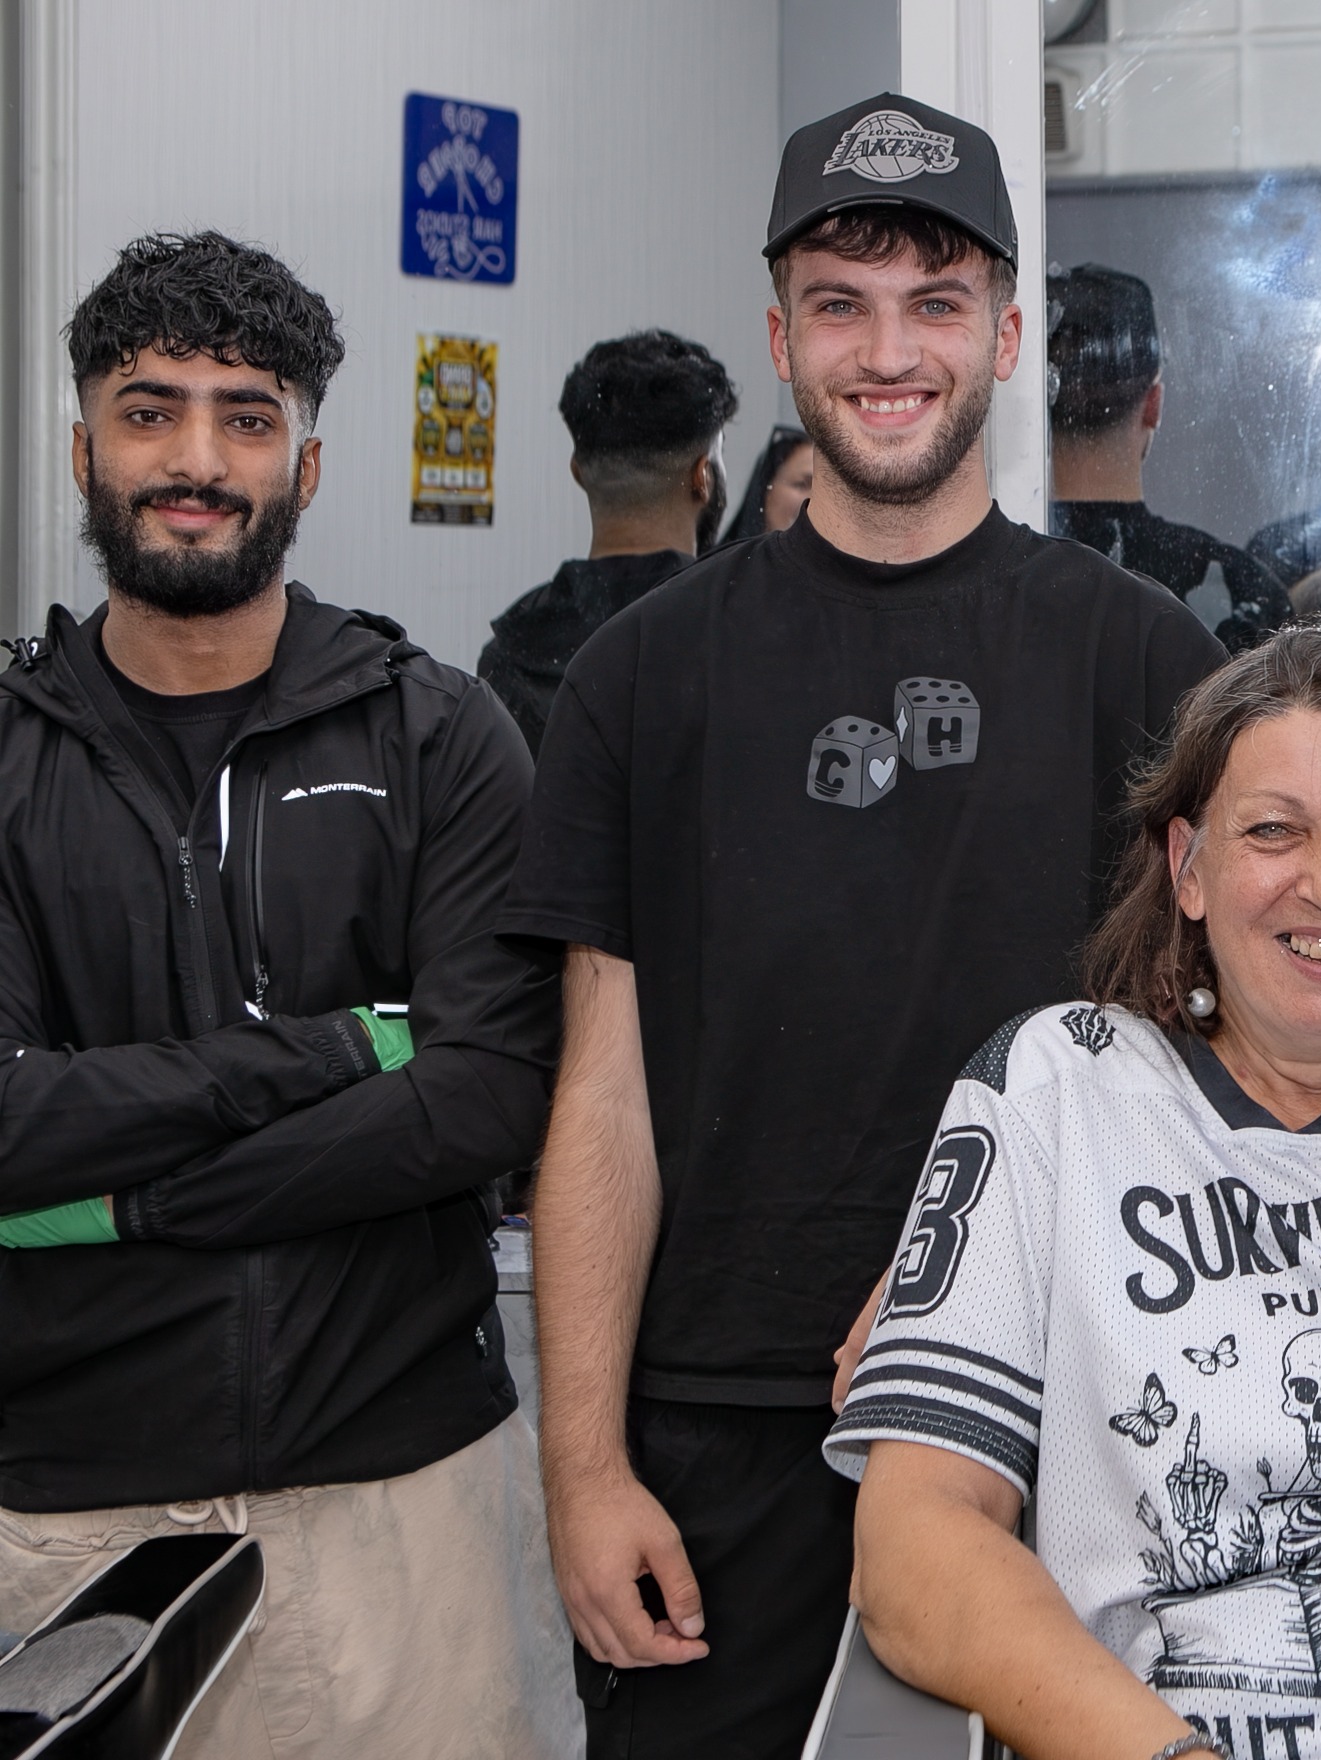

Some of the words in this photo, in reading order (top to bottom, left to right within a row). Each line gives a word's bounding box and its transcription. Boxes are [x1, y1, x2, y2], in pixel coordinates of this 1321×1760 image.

[826, 131, 955, 169] LAKERS
[868, 129, 892, 137] LOS
[894, 130, 950, 144] ANGELES
[814, 748, 851, 798] C
[927, 716, 963, 757] H
[310, 783, 387, 797] MONTERRAIN
[876, 1125, 997, 1329] 3
[1184, 1713, 1315, 1760] UT
